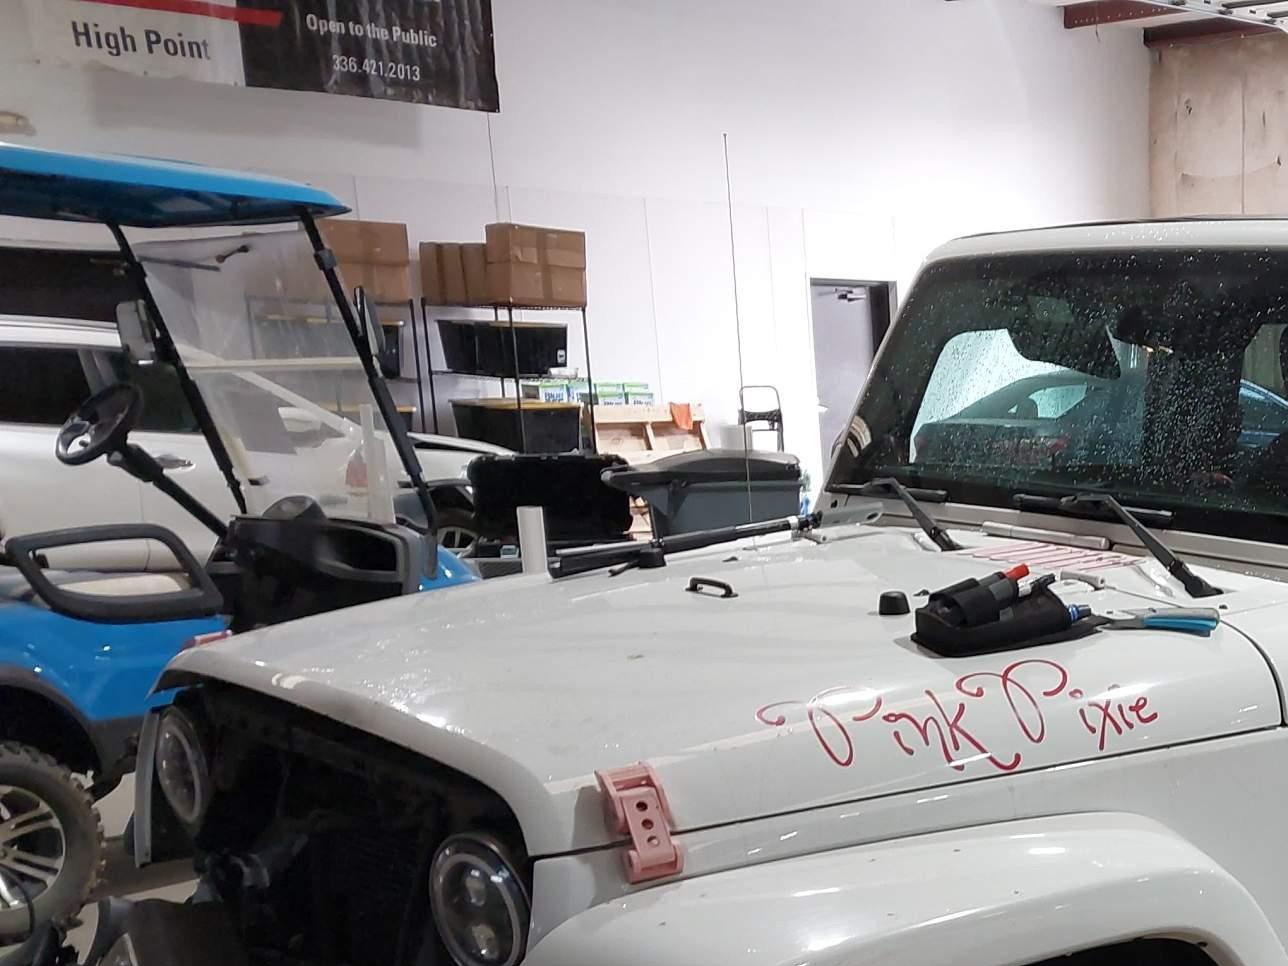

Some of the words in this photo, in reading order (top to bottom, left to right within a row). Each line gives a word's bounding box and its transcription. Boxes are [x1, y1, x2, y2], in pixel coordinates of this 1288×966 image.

[71, 20, 137, 57] High
[144, 28, 211, 60] Point
[306, 13, 346, 36] Open
[349, 20, 365, 37] to
[366, 22, 390, 41] the
[392, 26, 438, 48] Public
[332, 54, 421, 81] 336.421.2013
[756, 686, 1020, 771] Pink
[957, 659, 1157, 751] Pixie
